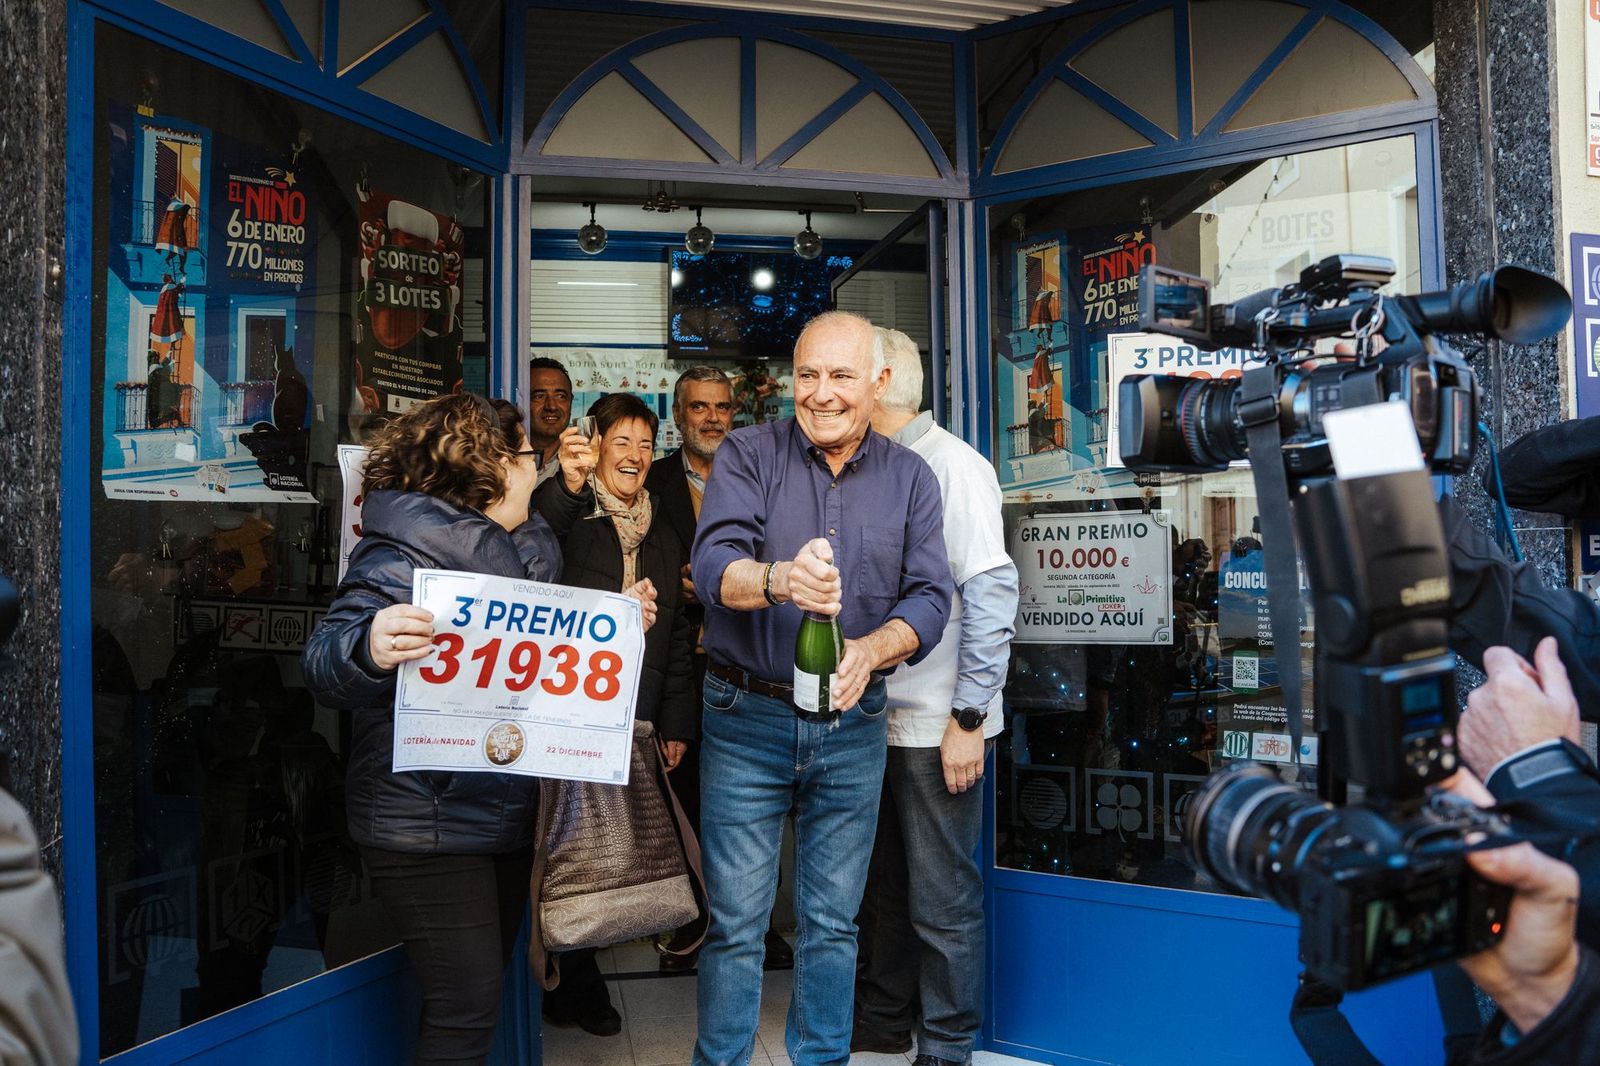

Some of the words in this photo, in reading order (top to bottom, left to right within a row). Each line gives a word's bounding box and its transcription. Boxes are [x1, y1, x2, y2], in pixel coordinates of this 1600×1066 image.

[229, 181, 243, 203] EL
[245, 181, 306, 226] NIÑO
[227, 208, 243, 238] 6
[244, 221, 262, 240] DE
[264, 222, 306, 245] ENERO
[1261, 209, 1335, 244] BOTES
[226, 241, 263, 270] 770
[264, 257, 304, 272] MILLONES
[378, 249, 440, 275] SORTEO
[1083, 259, 1098, 276] EL
[1098, 241, 1157, 283] NIÑO
[263, 271, 274, 282] EN
[274, 272, 304, 284] PREMIOS
[375, 281, 386, 302] 3
[389, 284, 442, 310] LOTES
[1084, 278, 1098, 302] 6
[1100, 282, 1115, 298] DE
[1117, 275, 1139, 295] ENE
[1084, 298, 1117, 325] 770
[1119, 302, 1139, 316] MILL
[1119, 316, 1129, 326] EN
[374, 350, 398, 361] PARTICIPA
[398, 356, 409, 364] CON
[409, 358, 418, 366] TUS
[1021, 525, 1070, 542] GRAN
[1077, 522, 1148, 541] PREMIO
[1037, 547, 1117, 569] 10.000
[1121, 556, 1130, 567] €
[1047, 573, 1078, 581] SEGUNDA
[1079, 572, 1116, 580] CATEGORÍA
[512, 583, 552, 597] VENDIDO
[552, 588, 575, 600] AQUÍ
[1057, 595, 1068, 603] La
[1086, 594, 1126, 603] Primitiva
[484, 599, 617, 643] PREMIO
[1021, 612, 1094, 626] VENDIDO
[1100, 608, 1144, 626] AQUÍ
[418, 632, 624, 702] 31938
[403, 735, 431, 745] LOTERÍA
[440, 737, 476, 747] NAVIDAD
[546, 746, 556, 754] 22
[559, 748, 604, 759] DICIEMBRE
